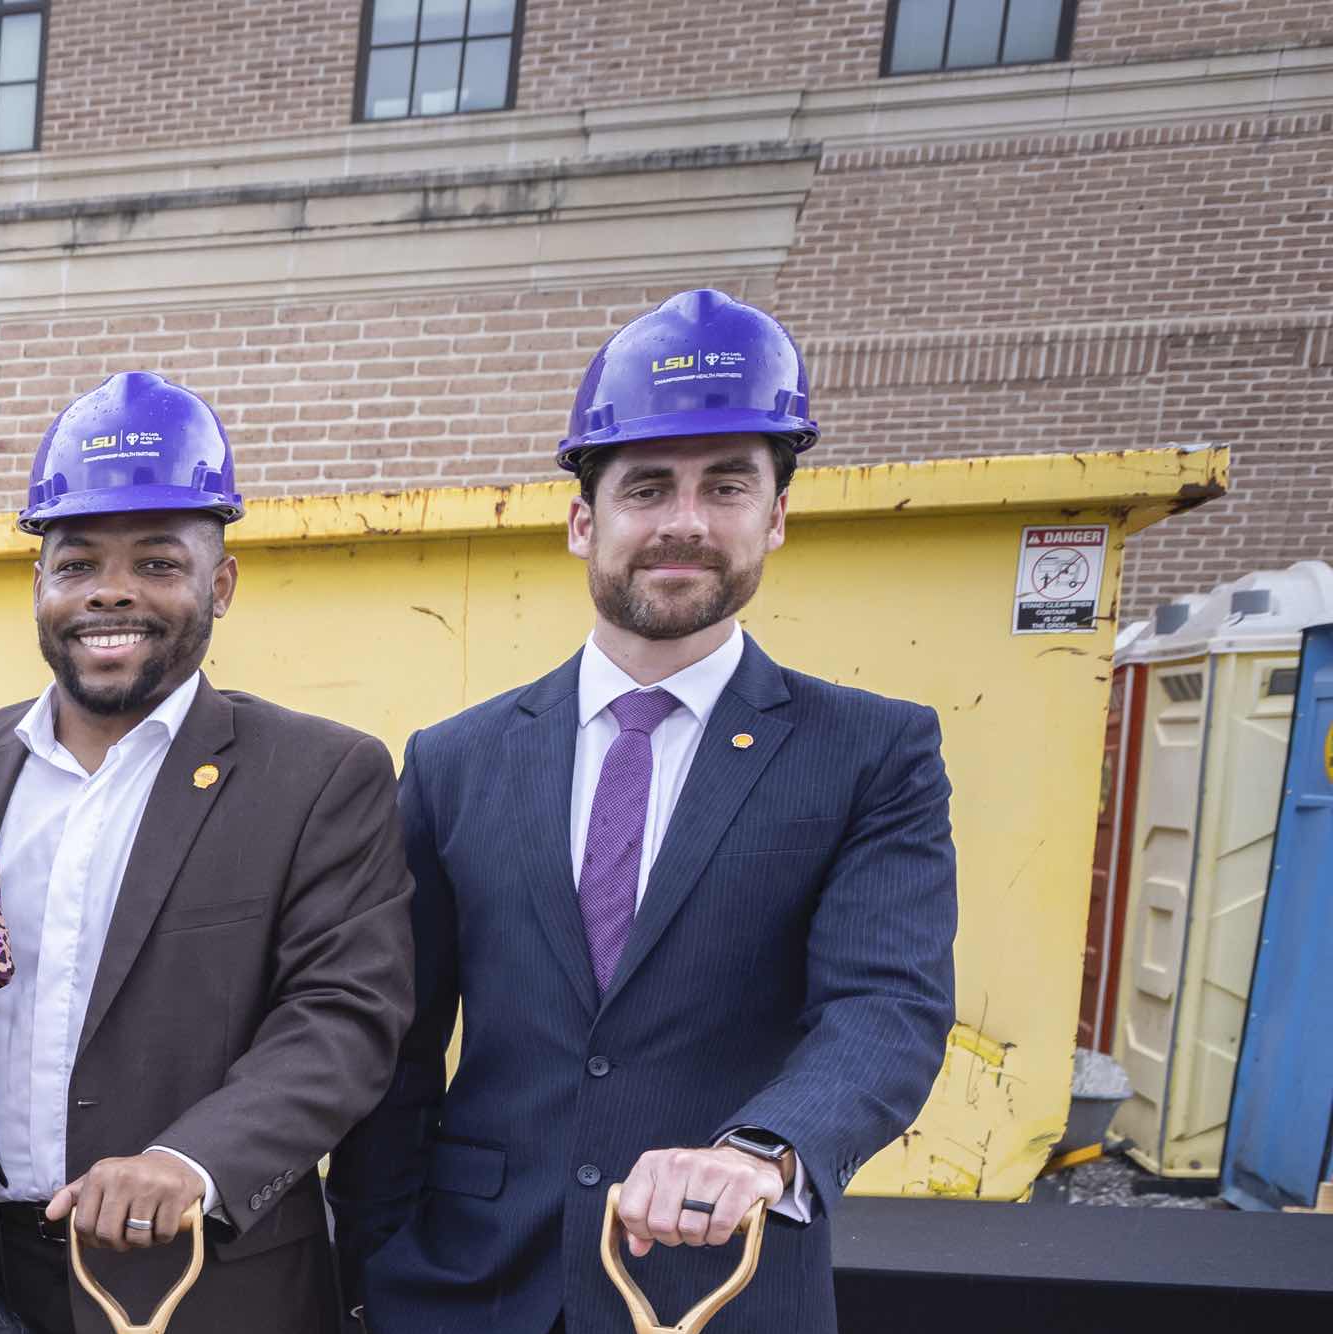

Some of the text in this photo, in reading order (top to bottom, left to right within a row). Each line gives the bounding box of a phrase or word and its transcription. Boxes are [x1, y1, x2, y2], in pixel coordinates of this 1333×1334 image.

[652, 355, 694, 373] LSU
[82, 435, 117, 451] LSU
[1044, 530, 1101, 543] DANGER
